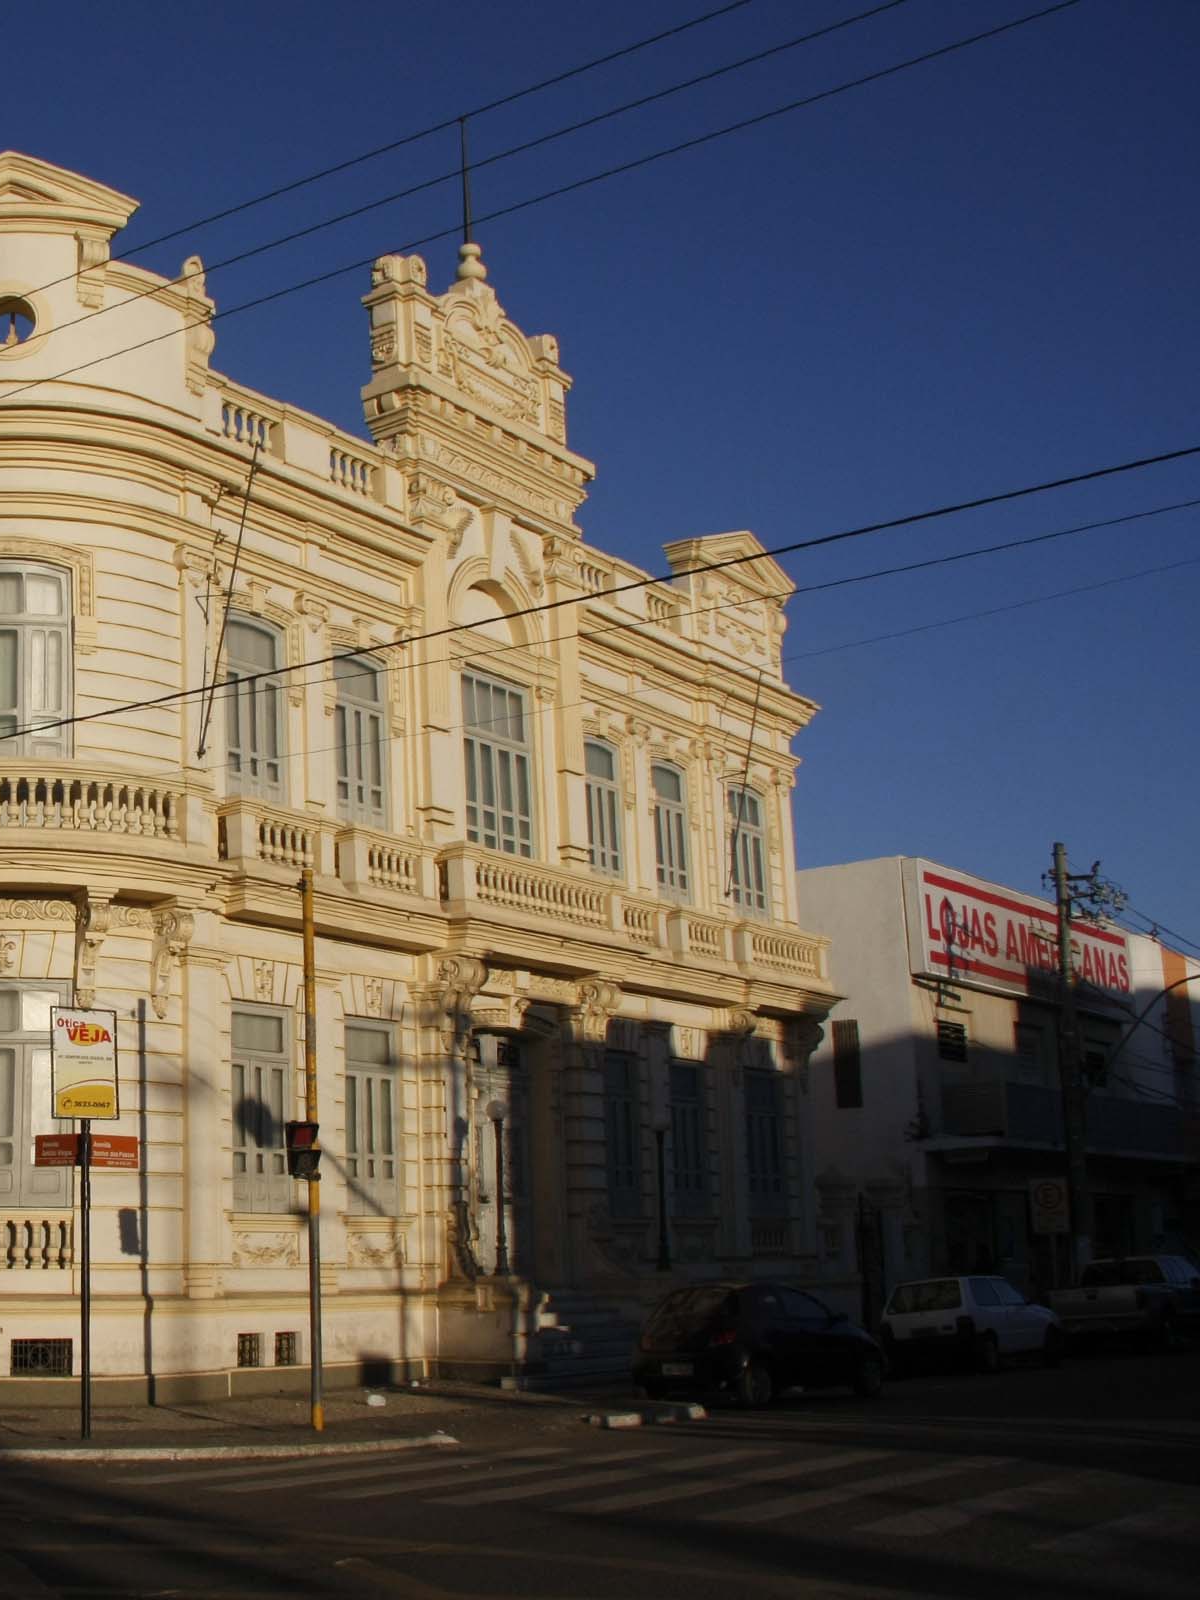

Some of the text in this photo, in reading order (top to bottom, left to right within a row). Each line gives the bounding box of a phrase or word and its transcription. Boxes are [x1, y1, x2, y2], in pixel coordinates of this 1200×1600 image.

[925, 893, 1130, 993] LOJAS AMERCANAS
[66, 1028, 112, 1043] VEJA
